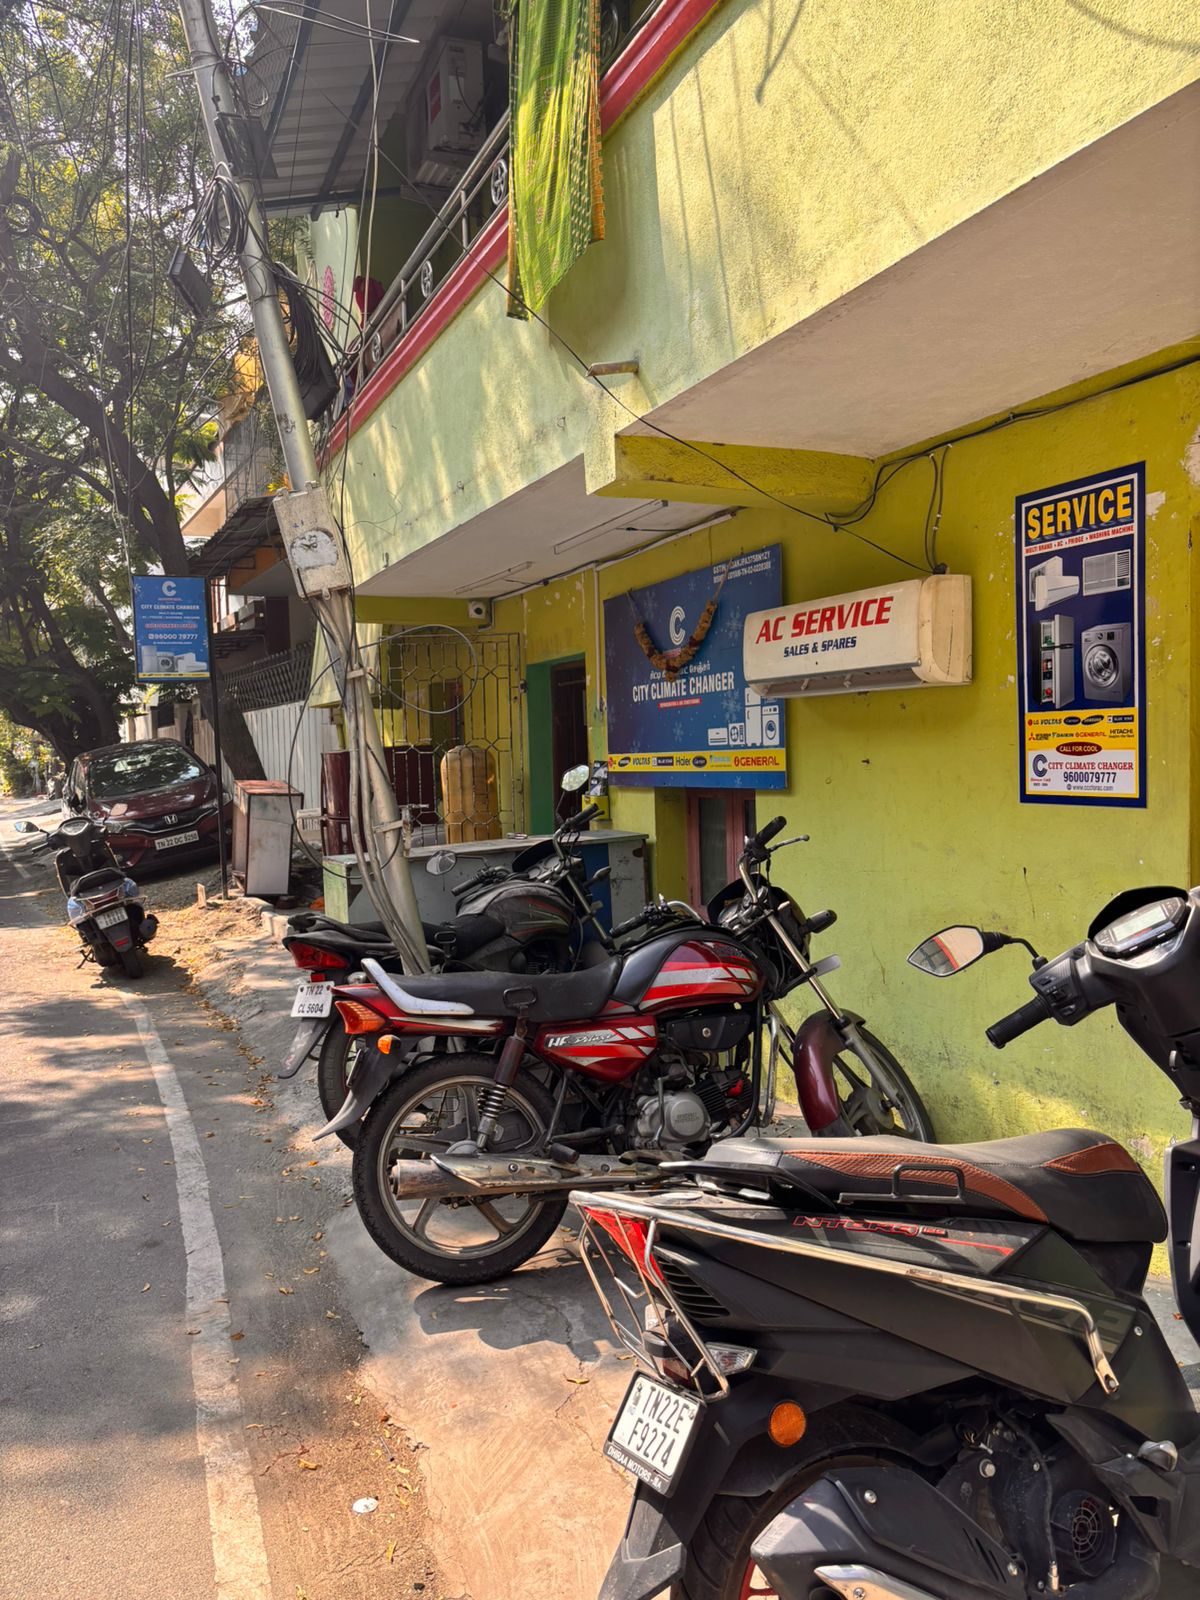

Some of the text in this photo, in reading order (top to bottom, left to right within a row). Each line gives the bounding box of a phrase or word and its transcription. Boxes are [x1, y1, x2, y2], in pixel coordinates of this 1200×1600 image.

[1027, 483, 1132, 540] SERVICE
[1067, 536, 1084, 545] FRIDGE
[1088, 530, 1110, 540] WASHING
[1111, 525, 1134, 536] MACHINE
[755, 596, 894, 644] AC SERVICE
[783, 636, 857, 658] SALES & SPARES
[632, 684, 649, 702] CITY
[650, 678, 687, 700] CLIMATE
[689, 671, 735, 695] CHANGER
[1072, 744, 1083, 752] FOR
[1083, 744, 1098, 752] COOL
[675, 756, 691, 767] Haier
[1048, 761, 1134, 771] CITY CLIMATE CHANGER
[1063, 771, 1117, 783] 9600079777
[315, 985, 324, 995] 22
[547, 1035, 570, 1048] HF
[642, 1385, 691, 1434] TN22E
[627, 1417, 676, 1469] F9274
[628, 1457, 652, 1481] MOTORS
